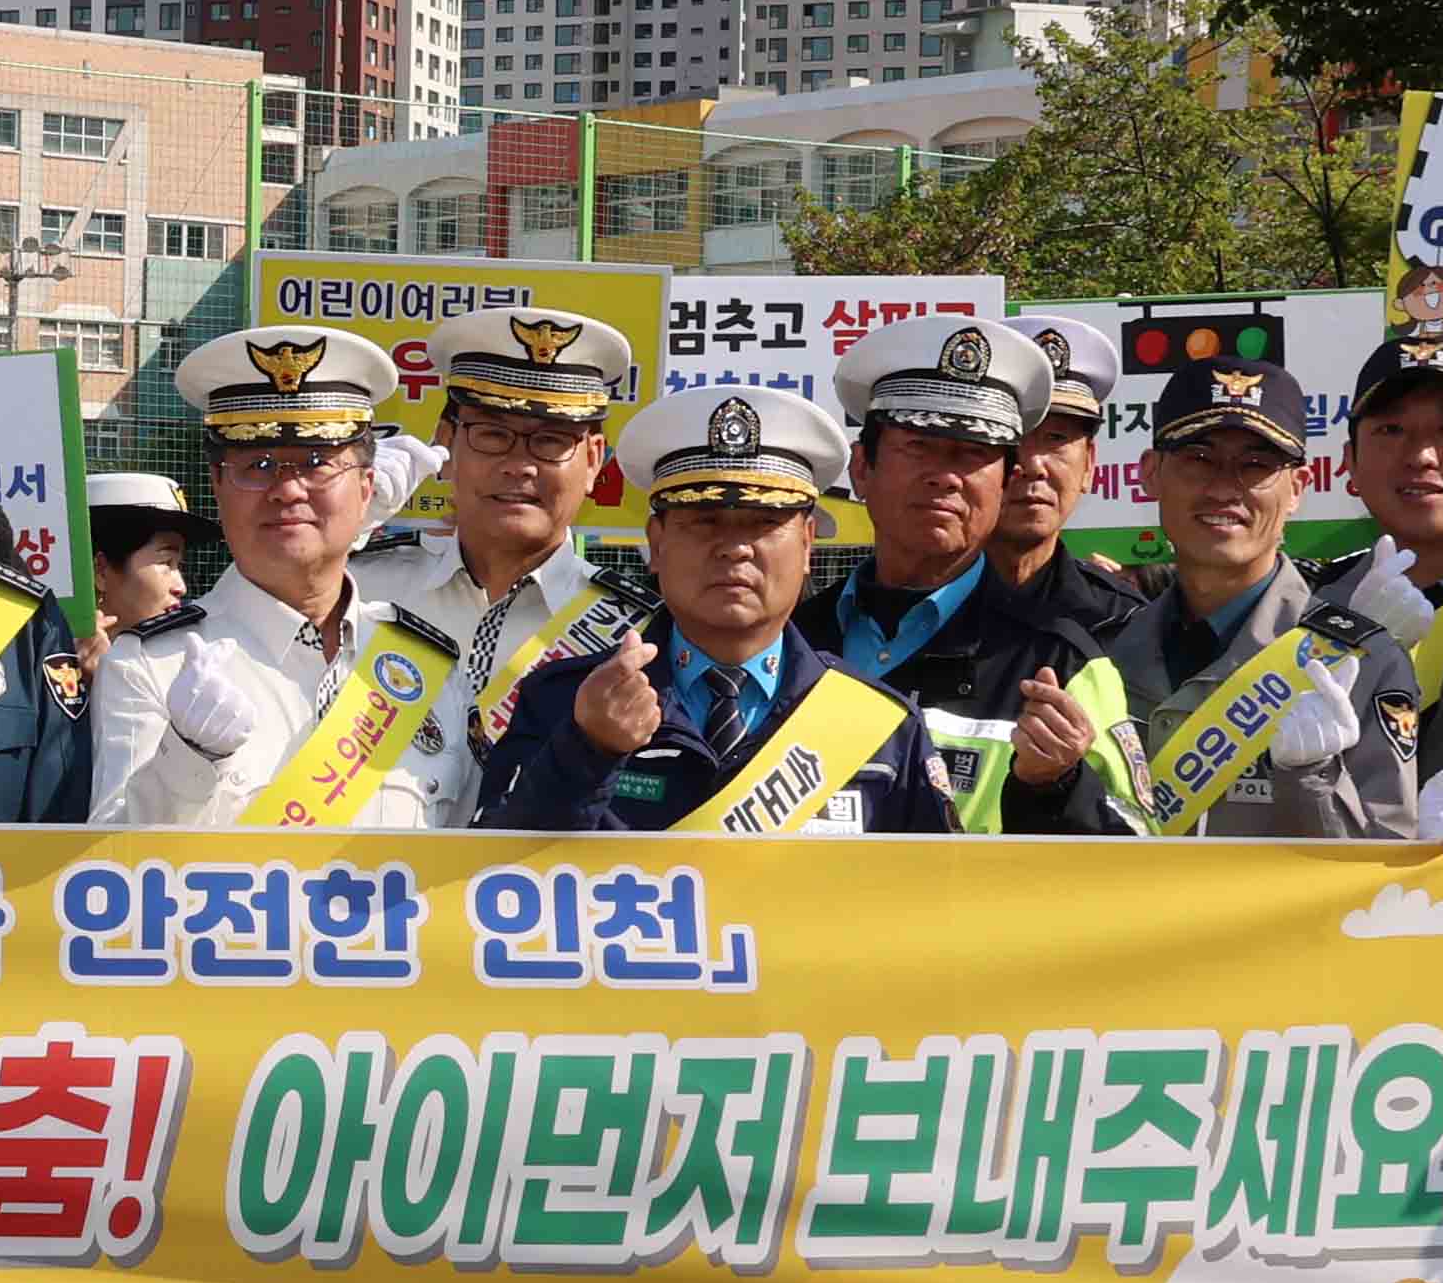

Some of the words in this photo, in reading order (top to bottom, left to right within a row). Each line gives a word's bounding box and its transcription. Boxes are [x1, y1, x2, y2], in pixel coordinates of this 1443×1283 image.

[312, 690, 398, 806] 어린이가
[1174, 725, 1238, 793] 아이
[1226, 673, 1292, 738] 우리
[61, 867, 417, 982] 안전한
[475, 868, 747, 986] 인천」
[239, 1046, 765, 1246] 아이먼저
